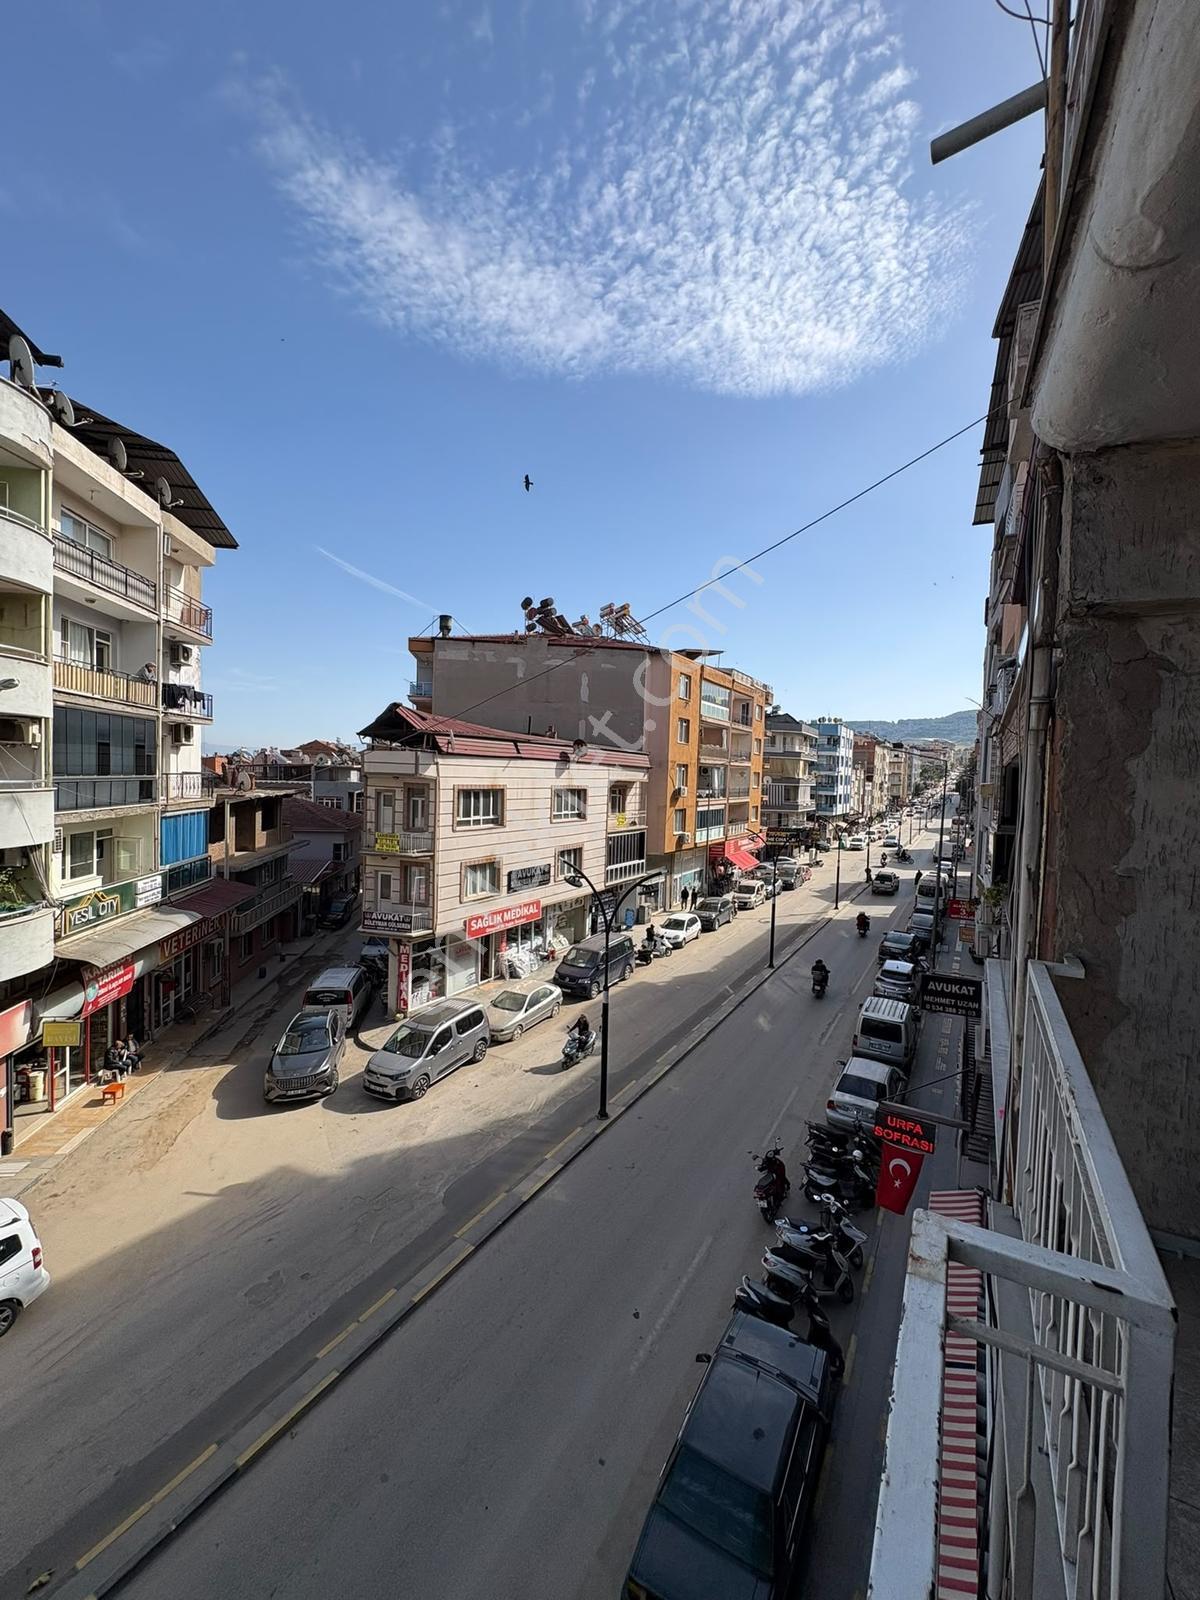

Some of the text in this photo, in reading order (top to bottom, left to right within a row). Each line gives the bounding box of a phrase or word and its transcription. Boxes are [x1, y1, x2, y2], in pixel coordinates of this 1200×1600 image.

[517, 866, 545, 879] AVUKAT
[371, 912, 404, 922] AVUKAT
[503, 904, 539, 922] MEDİKAL
[97, 966, 125, 986] TARIM
[927, 981, 976, 996] AVUKAT
[923, 995, 979, 1009] MEHMET UZAN
[887, 1115, 924, 1136] URFA
[873, 1126, 934, 1153] SOFRASI
